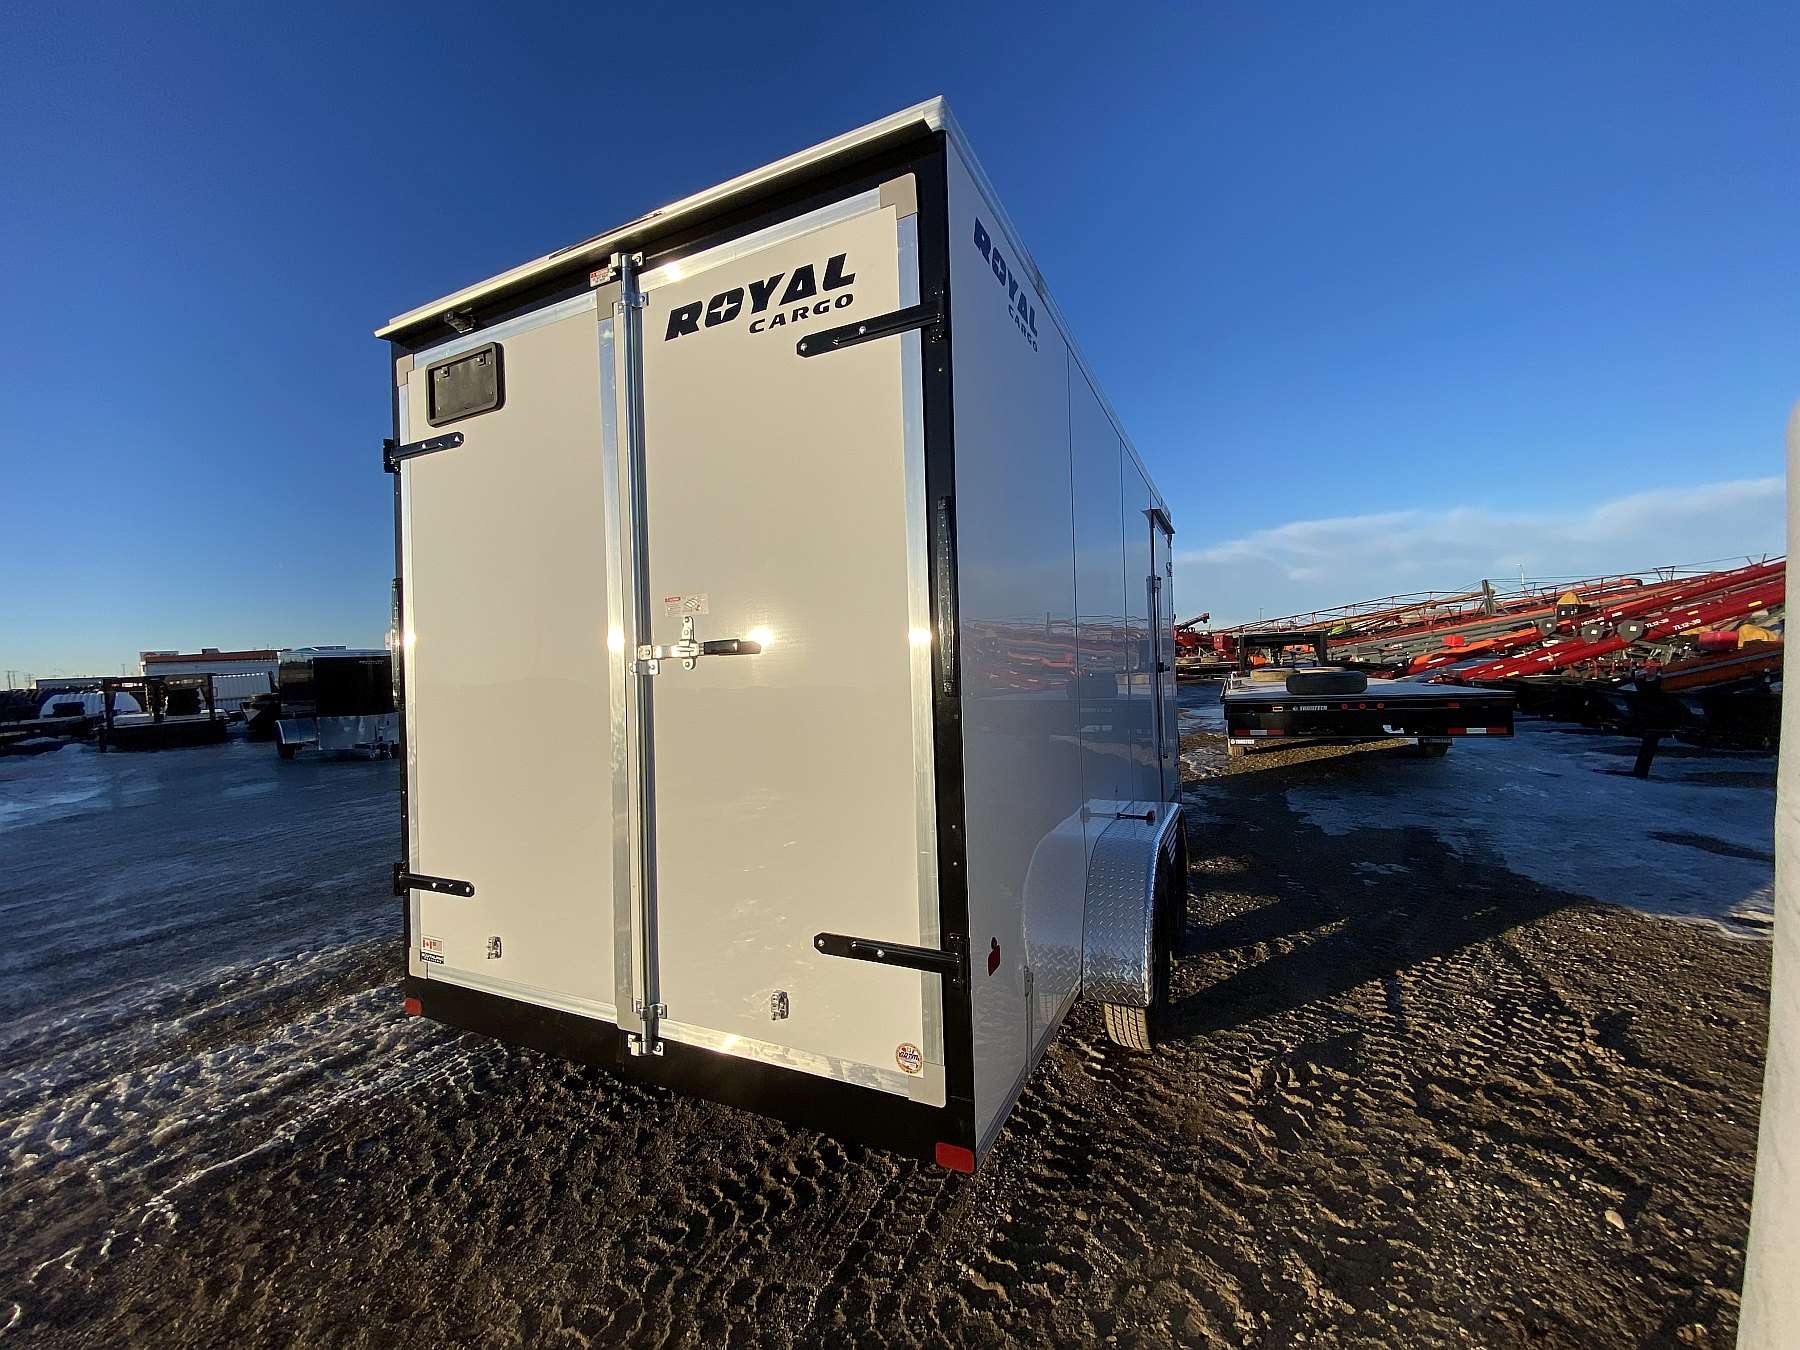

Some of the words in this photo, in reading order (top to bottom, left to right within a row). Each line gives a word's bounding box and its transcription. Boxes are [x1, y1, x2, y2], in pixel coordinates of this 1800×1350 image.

[664, 253, 856, 341] ROYAL
[974, 216, 1038, 338] ROYAL
[749, 293, 855, 334] CARGO
[1008, 304, 1038, 353] CARGO
